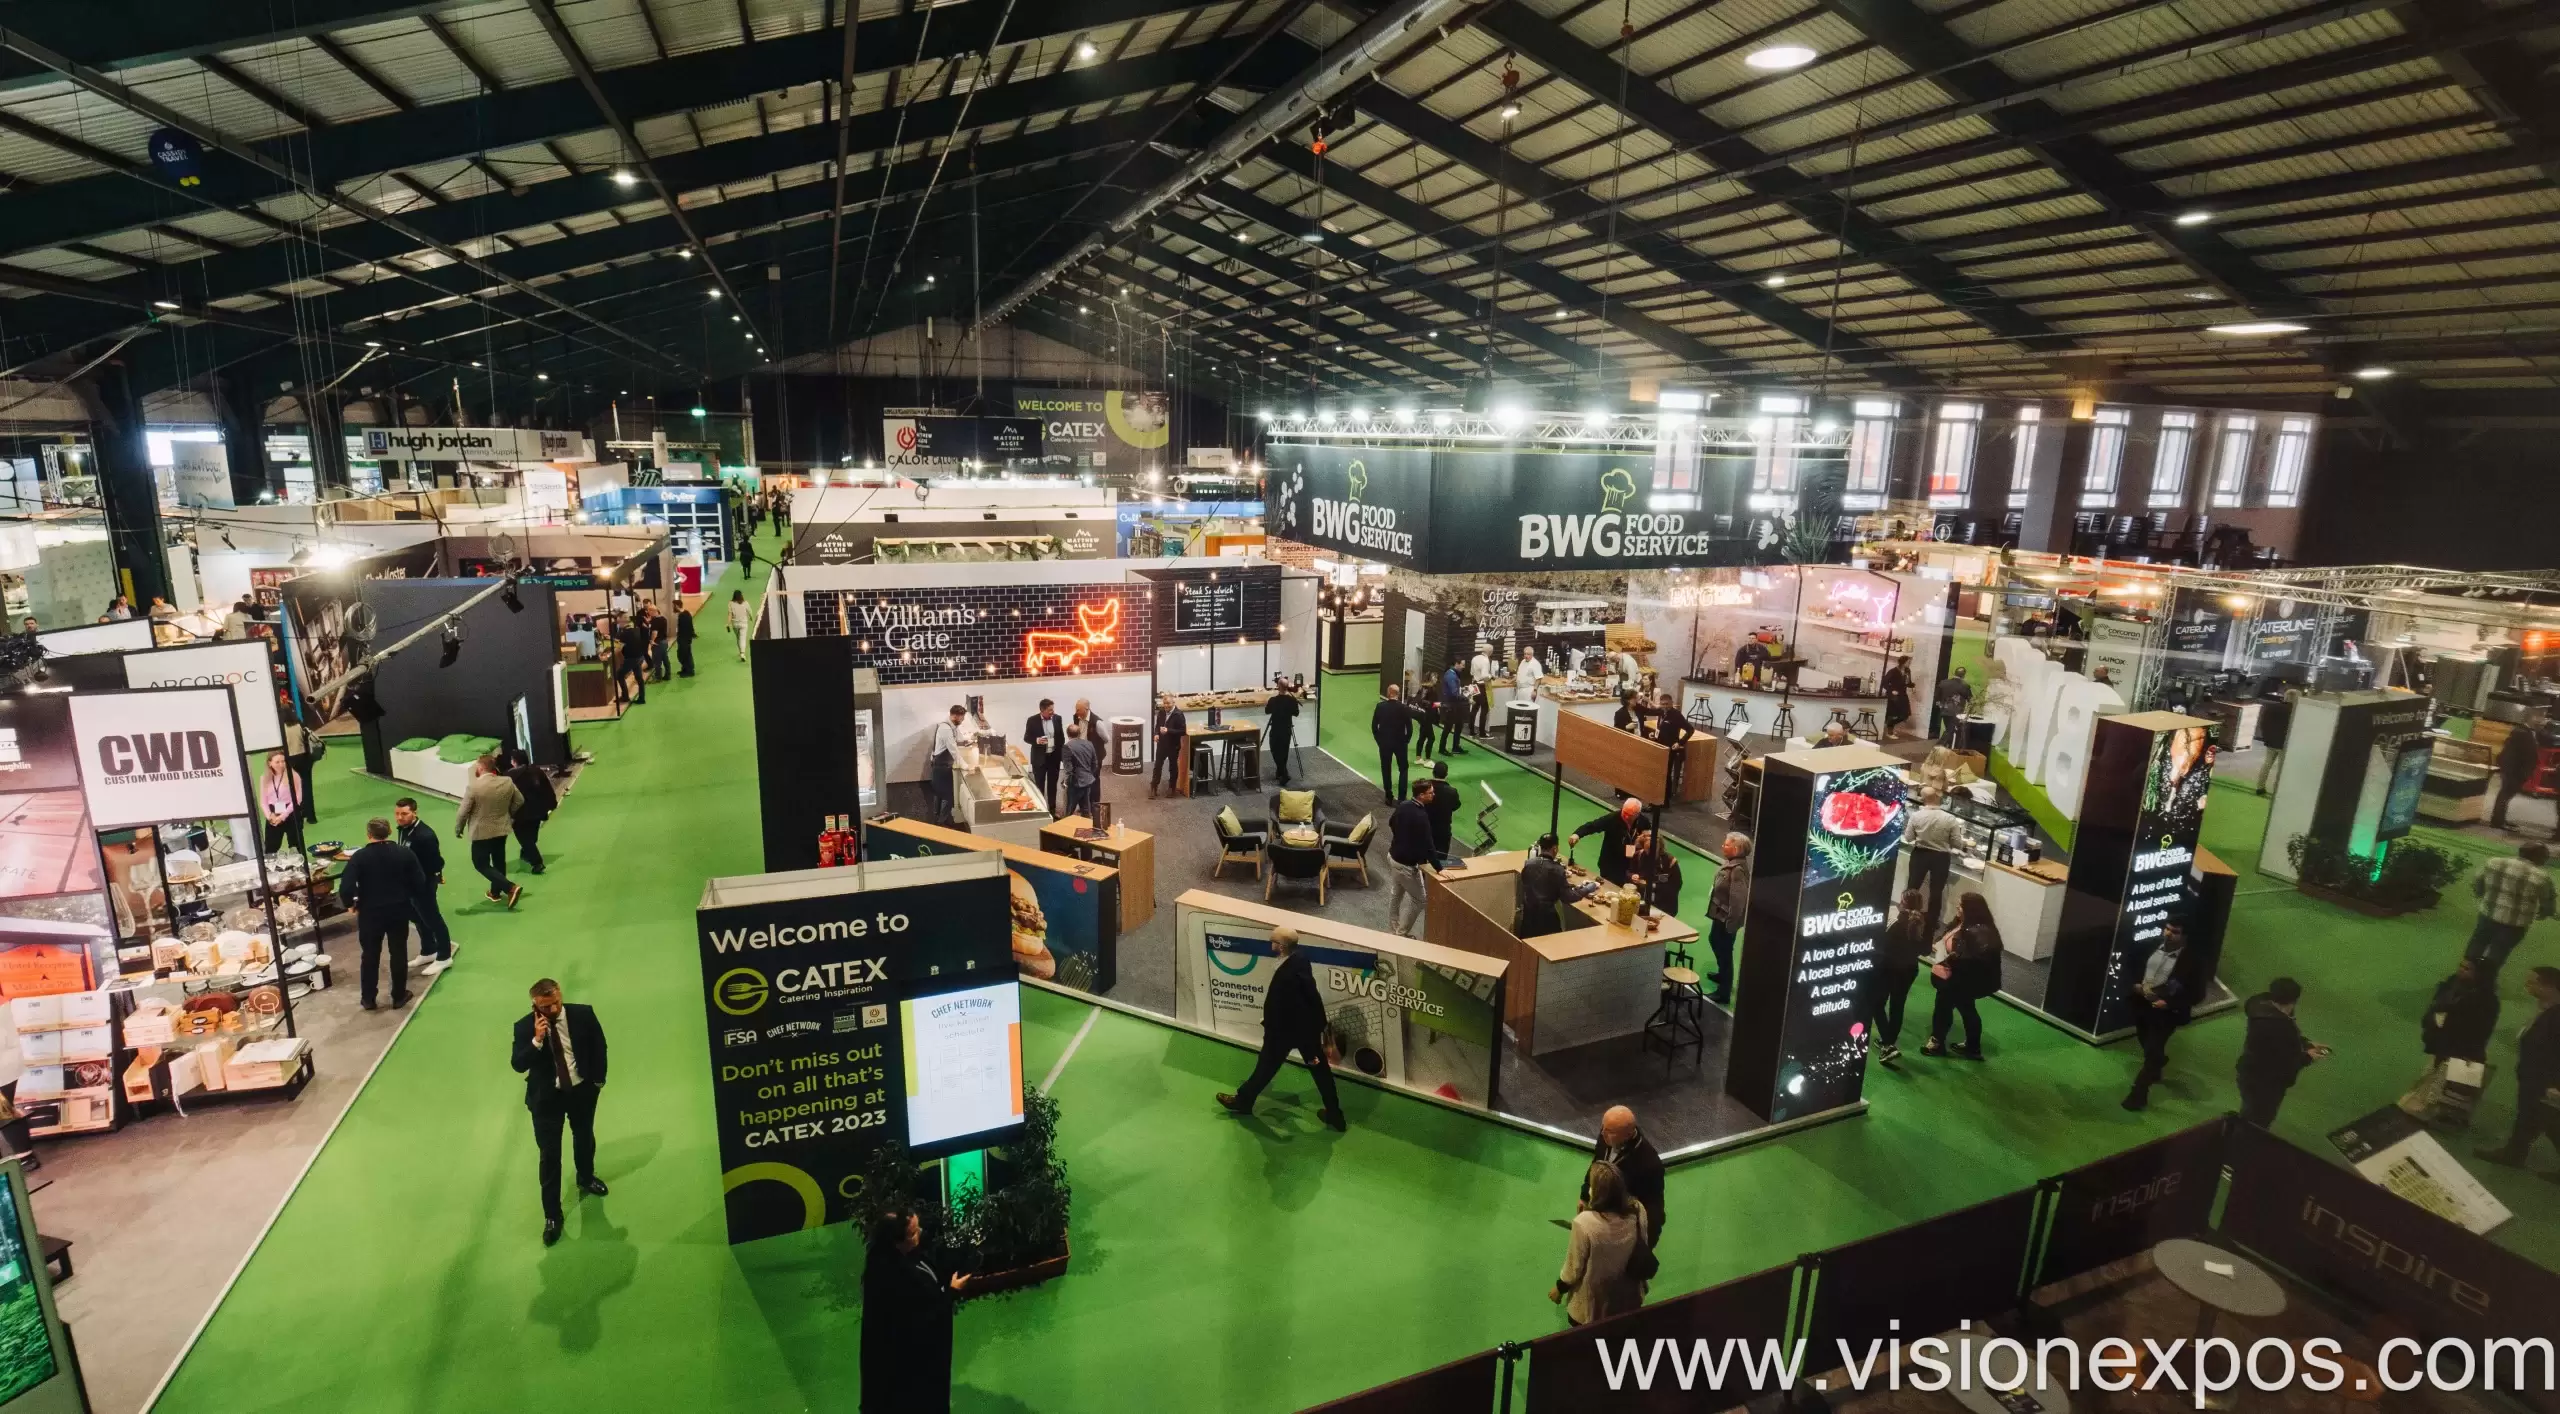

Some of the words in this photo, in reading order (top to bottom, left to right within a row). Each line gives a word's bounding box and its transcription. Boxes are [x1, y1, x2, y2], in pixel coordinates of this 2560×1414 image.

[1018, 400, 1083, 412] WELCOME
[1087, 402, 1103, 412] TO
[1049, 421, 1105, 437] CATEX
[388, 432, 434, 451] hugh
[437, 432, 492, 451] jordan
[457, 449, 490, 457] Catering
[888, 455, 929, 465] CALOR
[1312, 497, 1360, 543] BWG
[1361, 505, 1396, 529] FOOD
[1361, 526, 1413, 555] SERVICE
[1519, 513, 1621, 558] BWG
[1625, 514, 1684, 535] FOOD
[1623, 535, 1709, 556] SERVICE
[1185, 585, 1203, 596] Steak
[1481, 588, 1519, 603] Coffee
[860, 603, 975, 628] William's
[1479, 620, 1487, 628] A
[1489, 616, 1514, 628] GOOD
[885, 624, 950, 651] Gate
[1486, 629, 1507, 640] idea
[2108, 628, 2140, 637] corcoran
[2176, 624, 2217, 635] CATERLINE
[872, 658, 910, 667] MASTER
[912, 656, 967, 665] VICTUALLER
[150, 670, 257, 688] ARCOROC
[2372, 711, 2415, 725] Welcome
[2415, 710, 2427, 720] to
[98, 730, 221, 776] CWD
[104, 775, 147, 785] CUSTOM
[149, 772, 180, 782] WOOD
[182, 769, 224, 779] DESIGNS
[2134, 850, 2166, 872] BWG
[2132, 884, 2138, 895] A
[2139, 883, 2156, 894] love
[2156, 879, 2166, 890] of
[2165, 875, 2183, 887] food.
[2126, 900, 2134, 912] A
[2135, 897, 2153, 910] local
[2153, 892, 2181, 907] service.
[1803, 911, 1846, 937] BWG
[1847, 906, 1873, 918] FOOD
[1846, 913, 1884, 928] SERVICE
[2134, 915, 2142, 925] A
[2142, 909, 2168, 924] can-do
[709, 918, 868, 954] Welcome
[876, 912, 909, 934] to
[2134, 926, 2162, 941] attitude
[1802, 951, 1812, 963] A
[1813, 949, 1835, 961] love
[1837, 943, 1848, 956] of
[1849, 938, 1874, 951] food.
[776, 956, 888, 993] CATEX
[1797, 970, 1807, 983] A
[1808, 965, 1833, 980] local
[1835, 959, 1873, 975] service.
[1211, 978, 1264, 993] Connected
[1328, 967, 1387, 1001] BWG
[1389, 983, 1426, 1001] FOOD
[1811, 986, 1820, 998] A
[1821, 979, 1857, 996] can-do
[779, 992, 820, 1004] Catering
[824, 985, 873, 998] Inspiration
[1212, 987, 1254, 1003] Ordering
[931, 1001, 954, 1018] CHEF
[954, 998, 993, 1011] NETWORK
[1388, 993, 1444, 1017] SERVICE
[1812, 998, 1850, 1016] attitude
[766, 1025, 785, 1038] CHEF
[786, 1021, 821, 1032] NETWORK
[865, 1017, 885, 1025] CALOR
[722, 1058, 784, 1081] Don't
[791, 1052, 840, 1071] miss
[846, 1043, 882, 1062] out
[758, 1084, 786, 1099] on
[793, 1075, 817, 1094] all
[824, 1066, 884, 1088] that's
[739, 1095, 857, 1126] happening
[864, 1088, 886, 1105] at
[745, 1120, 825, 1148] CATEX
[831, 1109, 887, 1133] 2023
[2091, 1171, 2182, 1223] inspire
[2302, 1195, 2490, 1316] inspire
